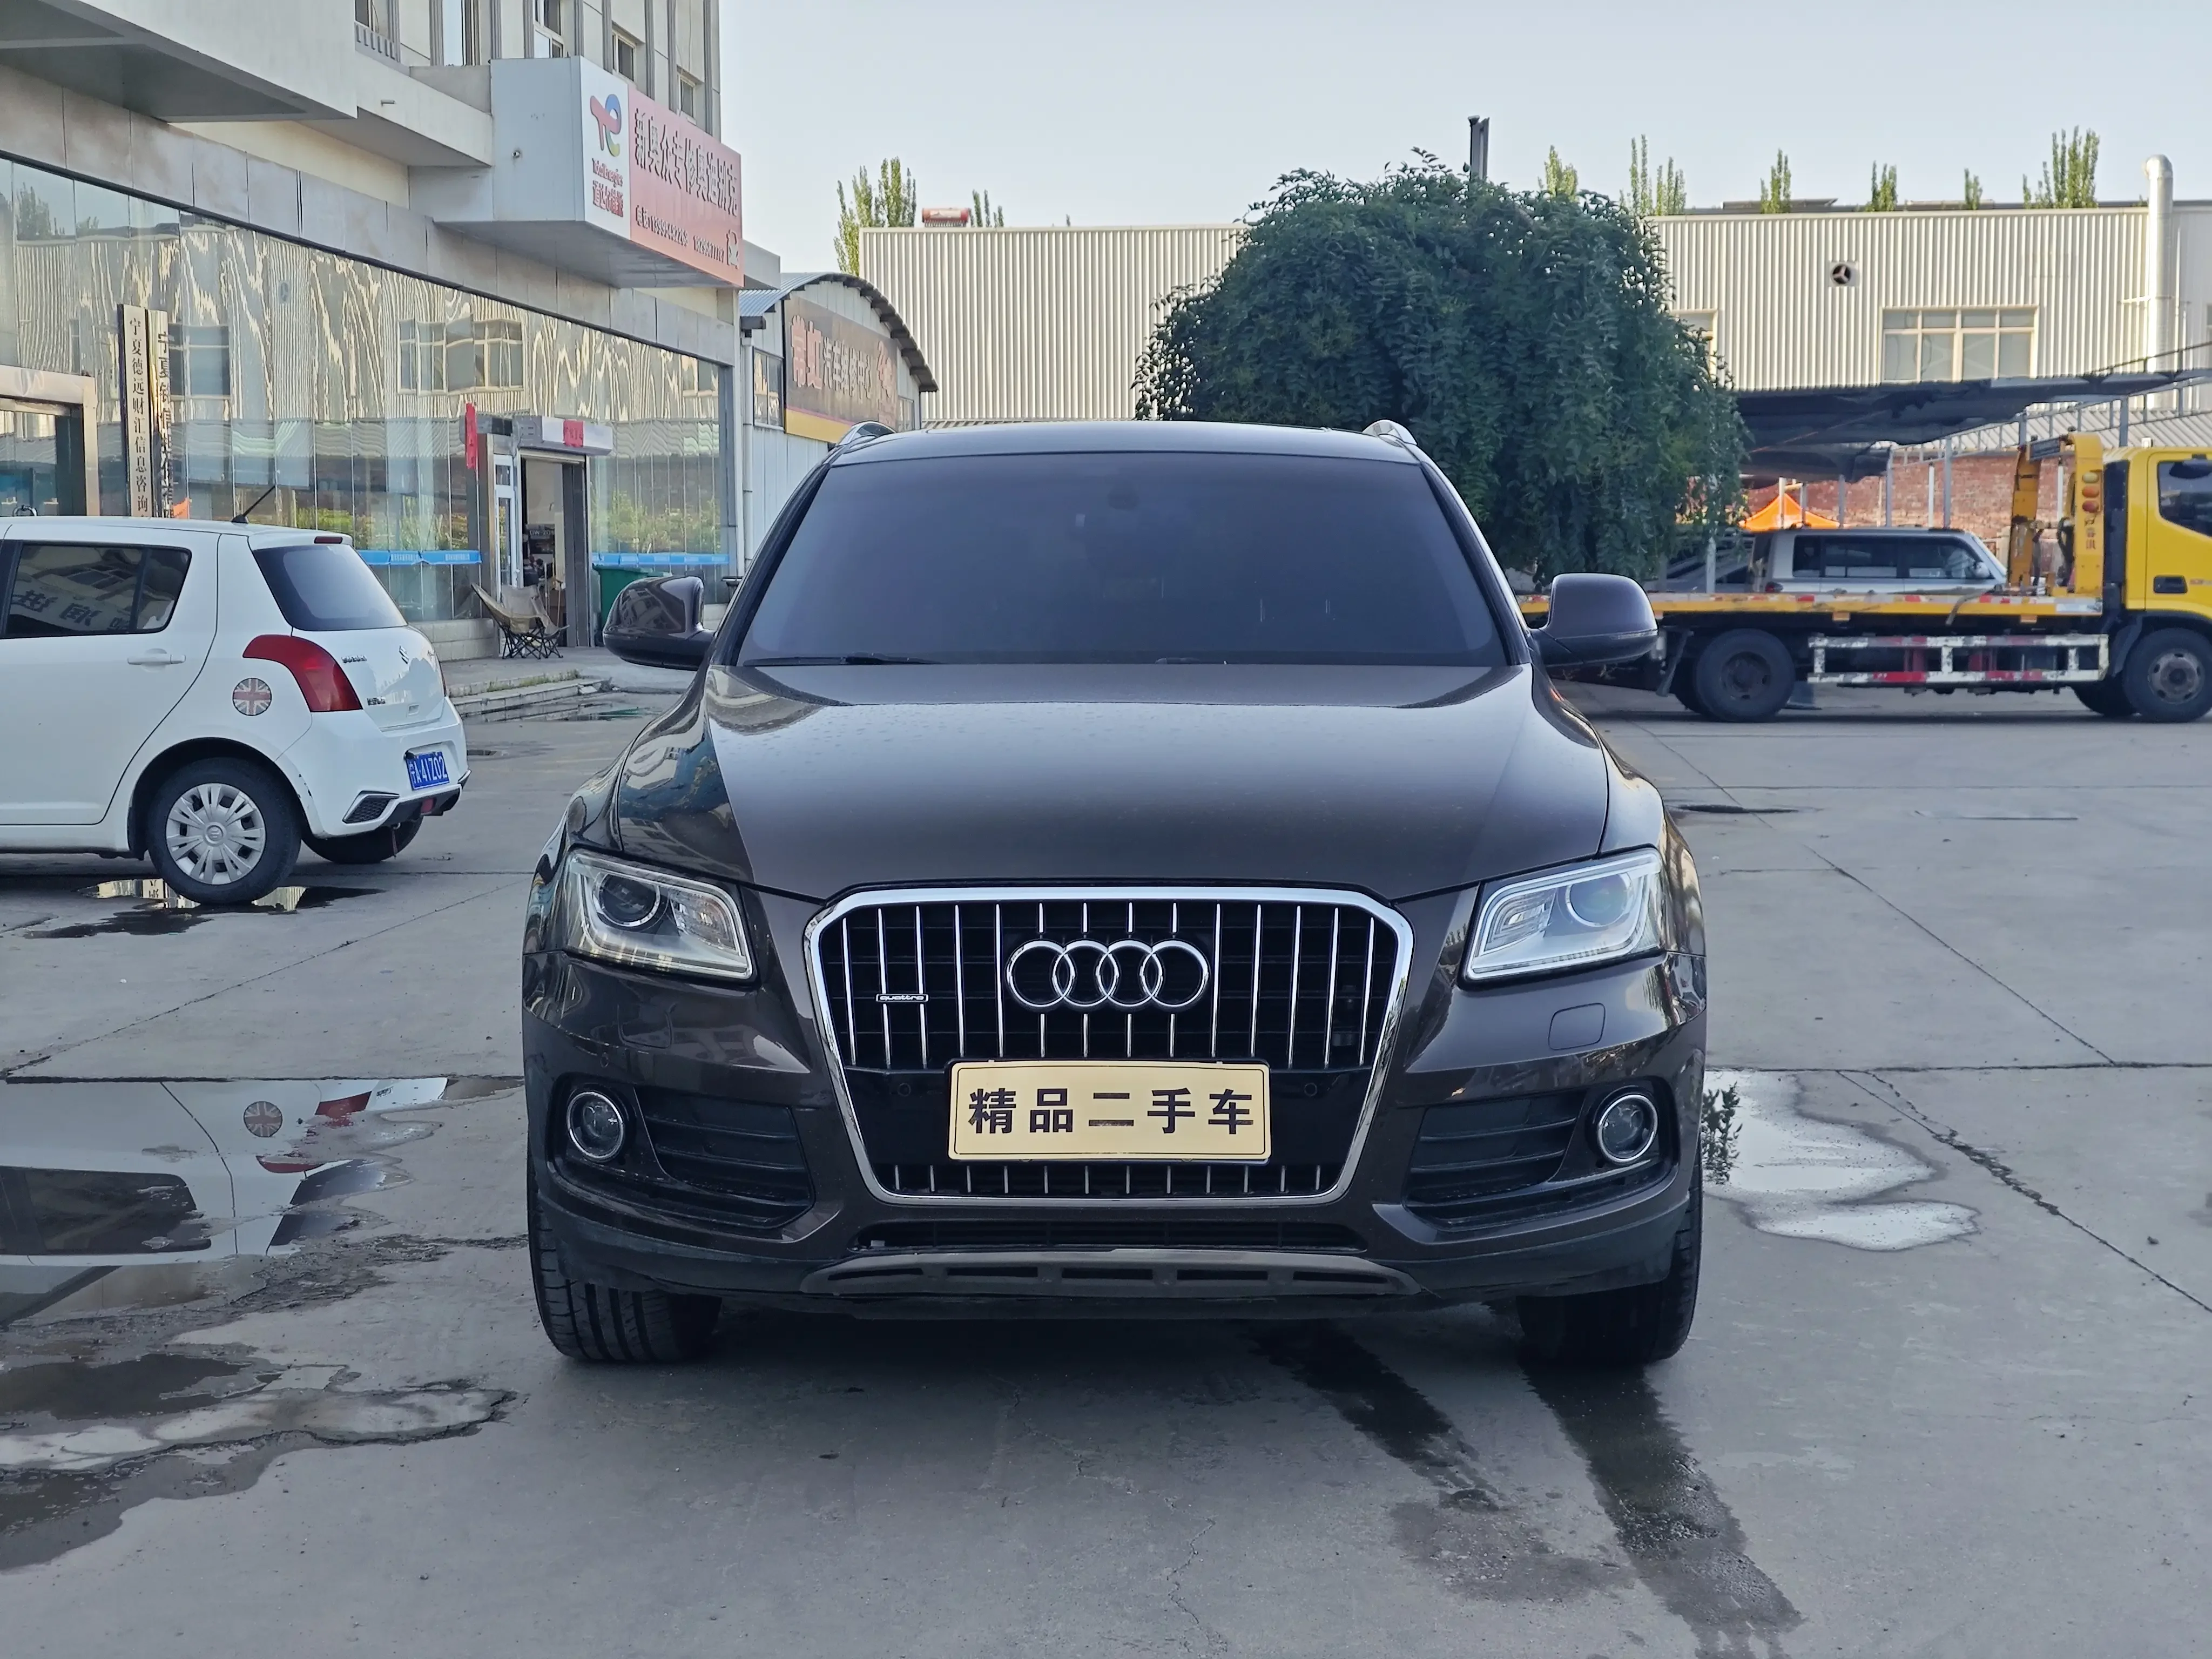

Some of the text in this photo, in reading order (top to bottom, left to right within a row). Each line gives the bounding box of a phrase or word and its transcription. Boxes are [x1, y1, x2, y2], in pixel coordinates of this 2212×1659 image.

[130, 318, 148, 517] 宁夏德远财汇信息咨询
[968, 1088, 1254, 1134] 精品二手车
